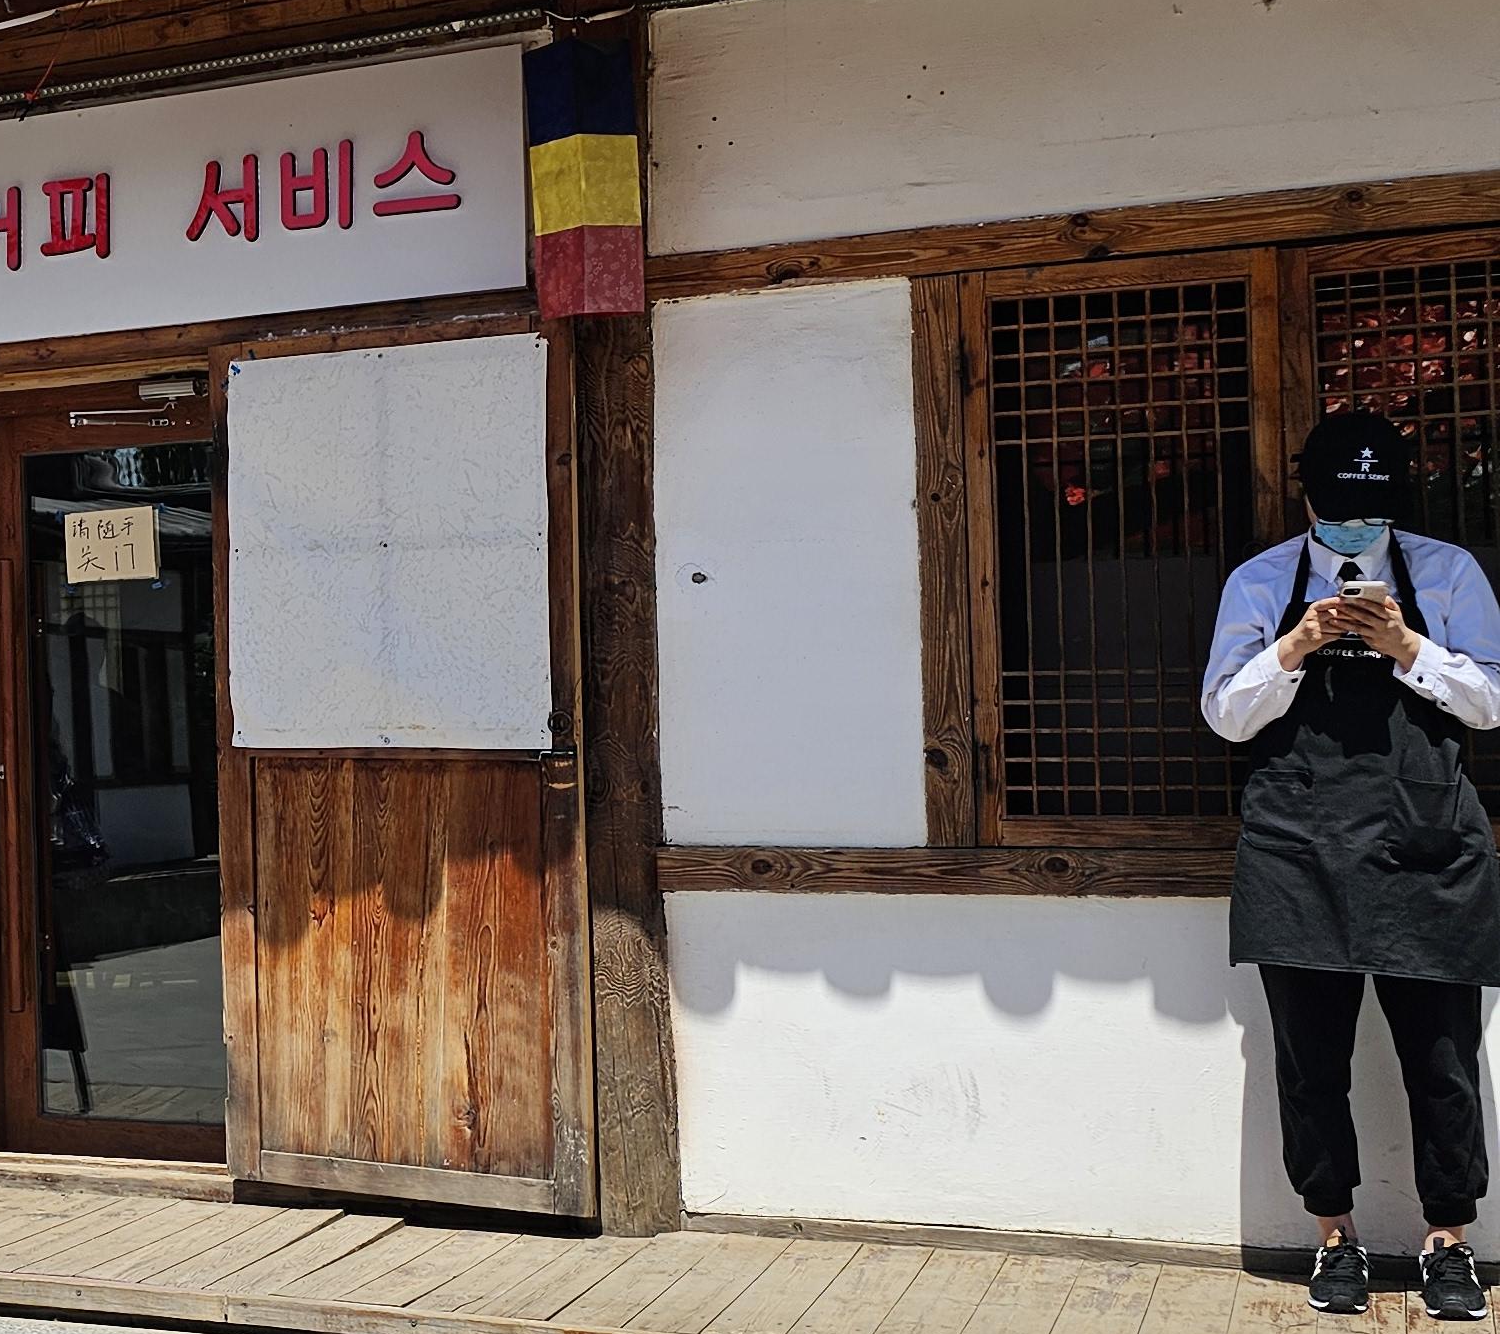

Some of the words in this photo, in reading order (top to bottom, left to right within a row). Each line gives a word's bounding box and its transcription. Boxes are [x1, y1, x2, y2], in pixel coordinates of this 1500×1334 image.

[186, 130, 461, 242] 서비스
[1336, 472, 1366, 480] COFFEE
[1361, 462, 1371, 473] R
[73, 516, 134, 540] 请随手
[77, 543, 135, 572] 关门
[1316, 648, 1355, 658] COFFEE
